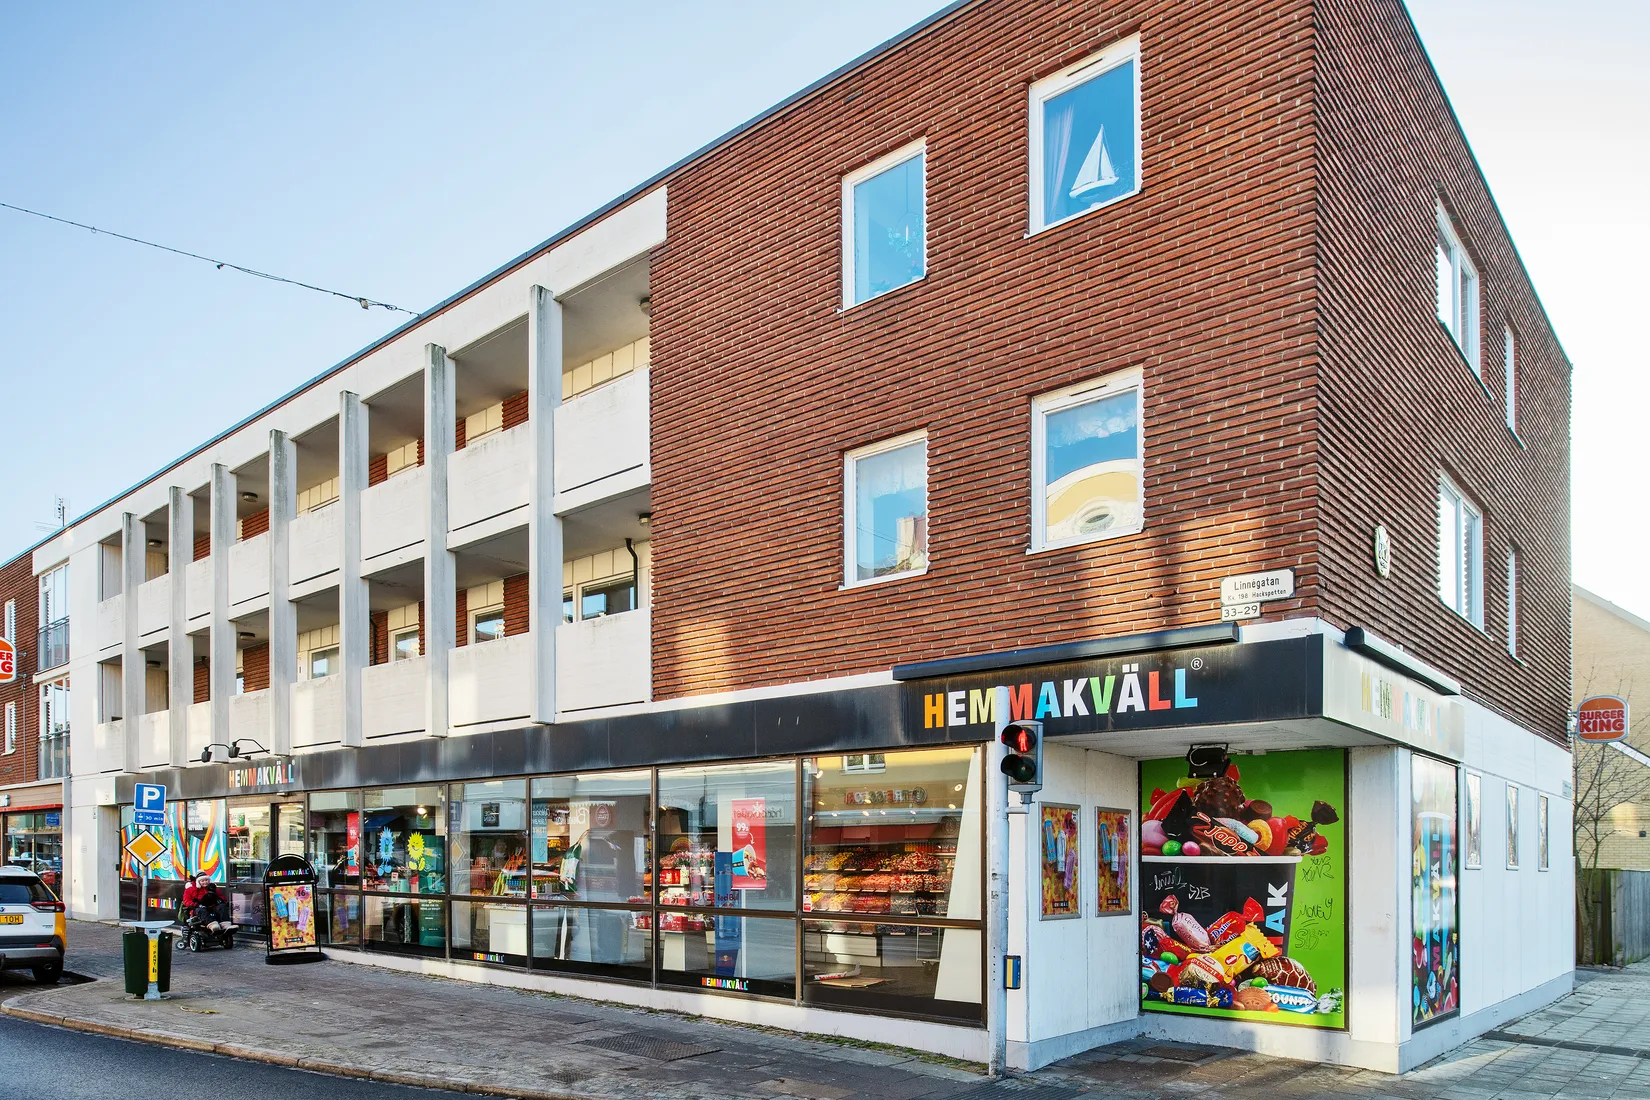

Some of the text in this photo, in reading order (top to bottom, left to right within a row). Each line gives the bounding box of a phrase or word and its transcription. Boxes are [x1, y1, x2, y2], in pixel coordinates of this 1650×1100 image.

[1234, 577, 1280, 590] Linnégatan
[1252, 588, 1287, 598] Hackspetten
[1224, 605, 1258, 618] 33-29
[924, 663, 1198, 729] HEMMAKVÄLL
[1580, 709, 1625, 721] BURGER
[1580, 719, 1625, 733] KING
[228, 760, 295, 788] HEMMAKVÄLL
[142, 786, 160, 809] P
[1203, 825, 1248, 852] Japp
[268, 867, 309, 877] HEMMAKVÄLL
[701, 976, 749, 991] HEMMAKVÄLL
